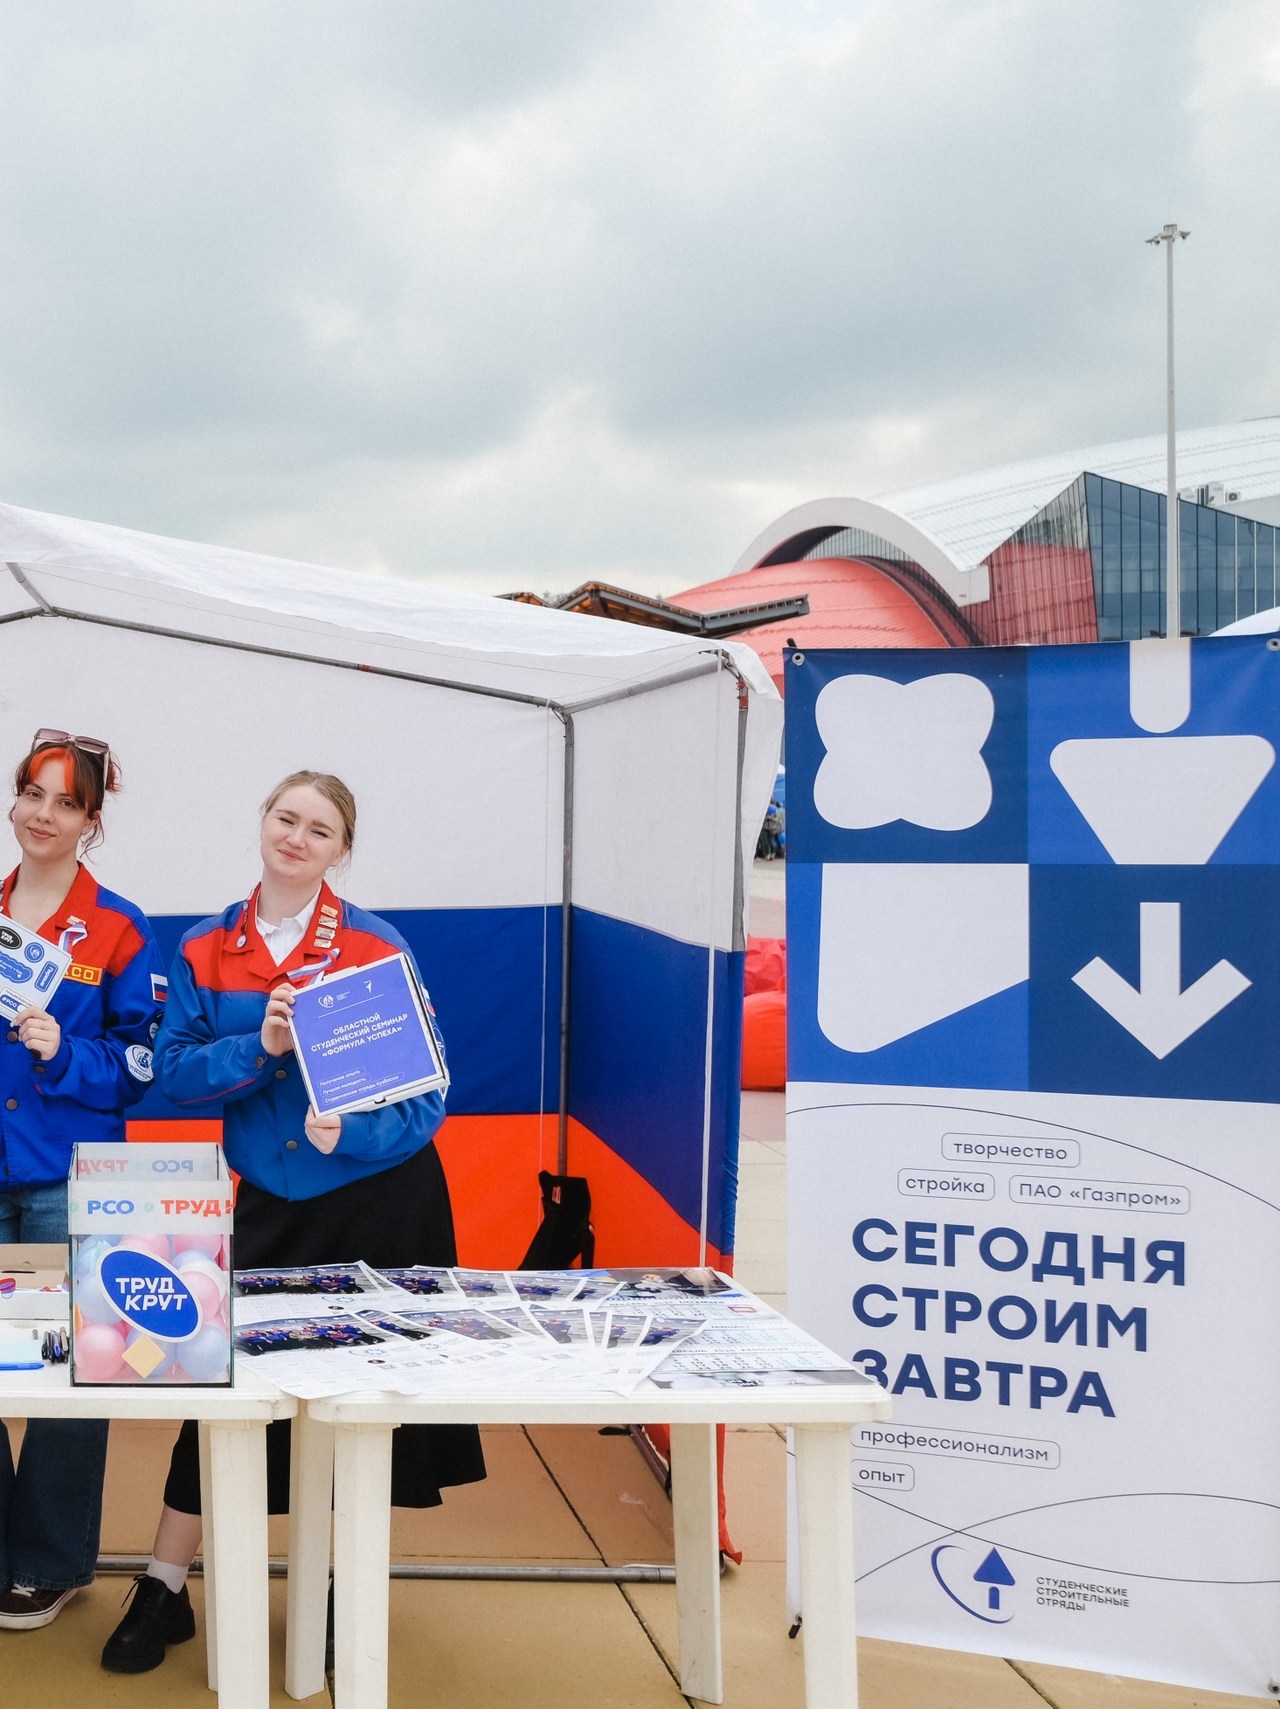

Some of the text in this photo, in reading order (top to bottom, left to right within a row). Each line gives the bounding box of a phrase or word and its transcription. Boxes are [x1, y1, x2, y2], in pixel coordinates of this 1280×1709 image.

[310, 1013, 408, 1053] СТУДЕНЧЕСКИЙ СЕМИНАР
[333, 1012, 381, 1035] ОБЛАСТНОЙ
[322, 1026, 402, 1058] «ФОРМУЛА УСПЕХА»
[953, 1142, 1068, 1161] творчество
[905, 1176, 1181, 1208] стройка ПАО «Газпром»
[87, 1199, 135, 1215] РСО
[160, 1199, 222, 1217] ТРУД
[852, 1217, 1186, 1287] СЕГОДНЯ
[115, 1277, 175, 1294] ТРУД
[124, 1294, 188, 1311] КРУТ
[852, 1284, 1148, 1353] СТРОИМ
[852, 1349, 1117, 1419] ЗАВТРА
[860, 1428, 1049, 1462] профессионализм
[858, 1468, 906, 1486] опыт
[1036, 1576, 1128, 1597] СТУДЕНЧЕСКИЕ
[1036, 1586, 1130, 1608] СТРОИТЕЛЬНЫЕ
[1036, 1596, 1086, 1612] ОТРЯДЫ
